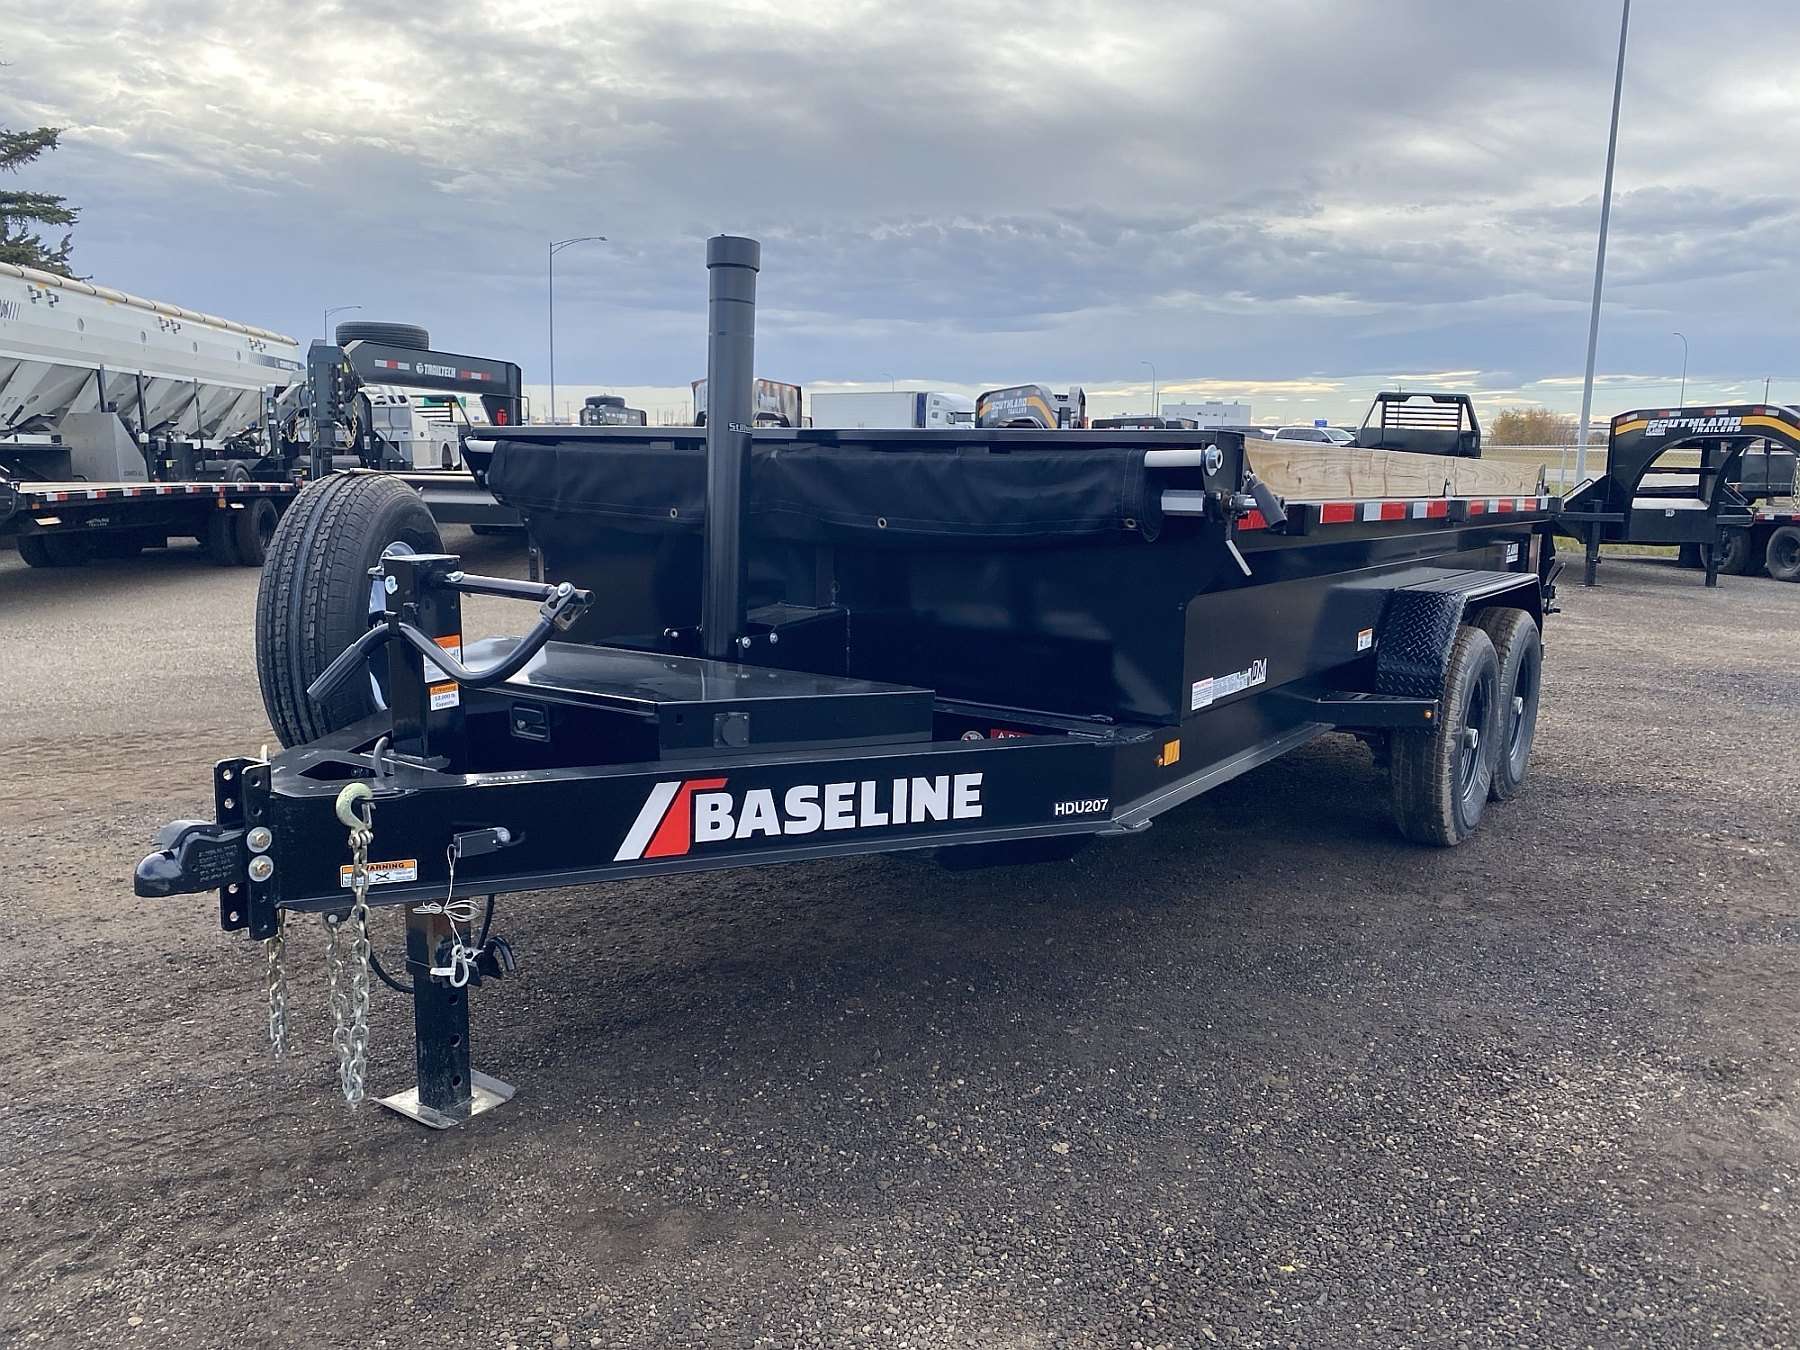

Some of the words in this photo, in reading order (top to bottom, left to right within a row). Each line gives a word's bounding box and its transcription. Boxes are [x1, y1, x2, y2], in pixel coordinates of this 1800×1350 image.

[424, 364, 457, 379] TRAILTECH
[992, 398, 1027, 410] SOUTHLAND
[1647, 416, 1742, 430] SOUTHLAND
[1691, 425, 1742, 433] TRAILERS
[694, 772, 984, 843] BASELINE
[1054, 799, 1109, 816] HDU207
